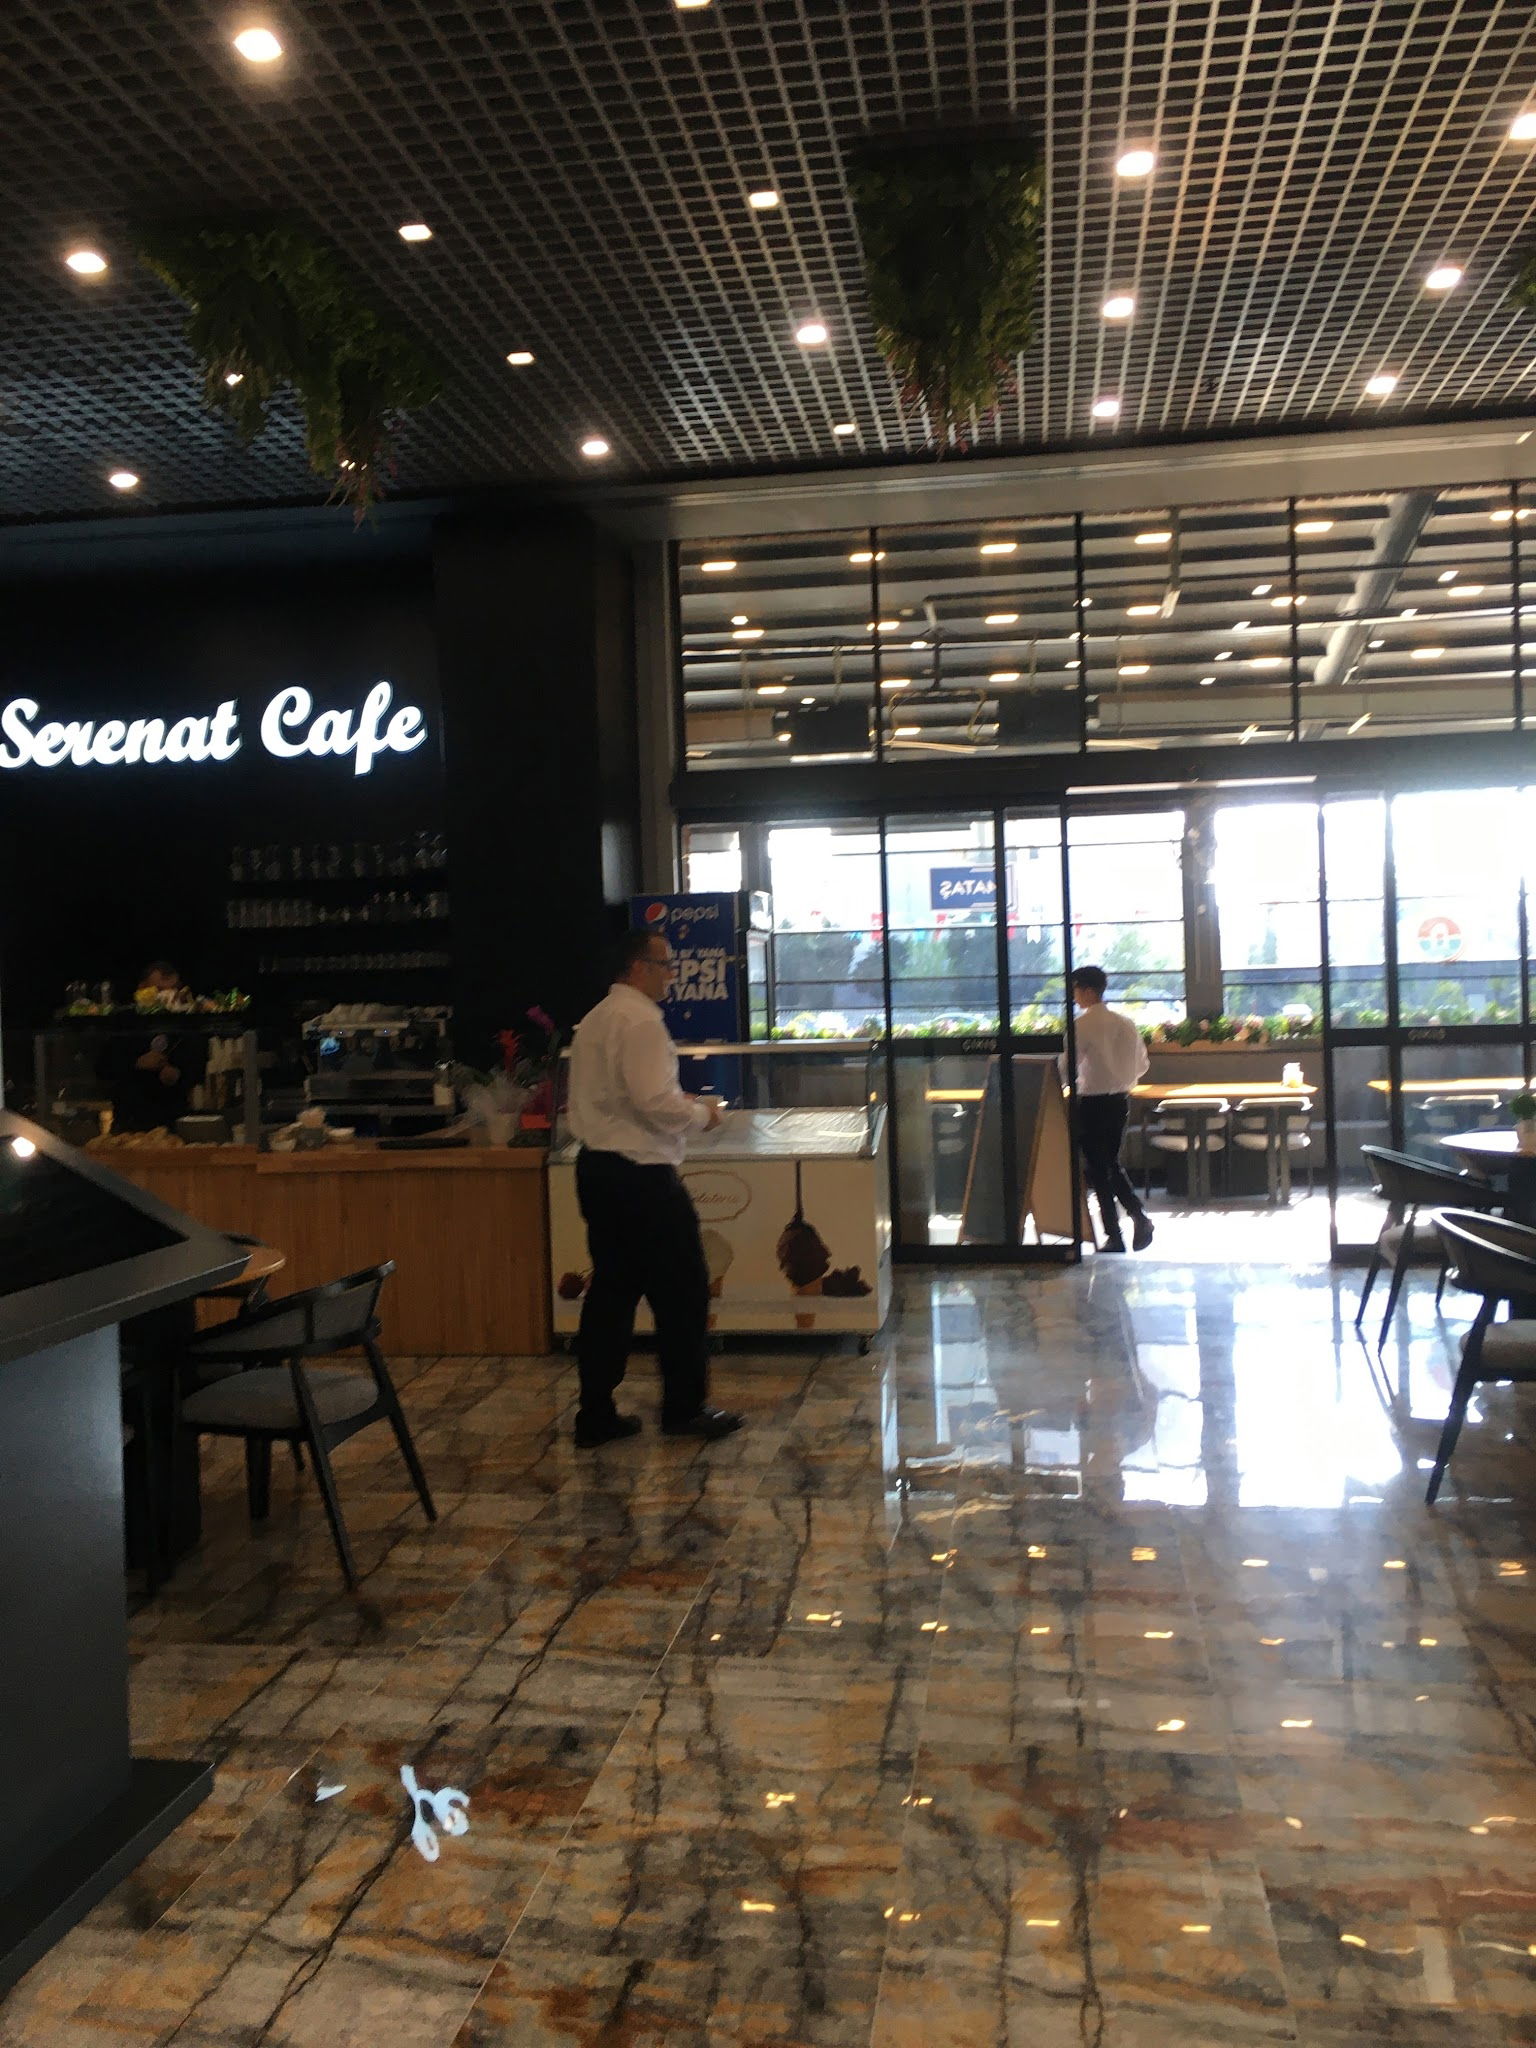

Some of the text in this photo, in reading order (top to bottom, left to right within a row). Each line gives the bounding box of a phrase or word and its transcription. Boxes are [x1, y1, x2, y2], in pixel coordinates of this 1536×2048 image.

[0, 680, 428, 776] Serenat Cafe
[670, 904, 720, 923] pepsi
